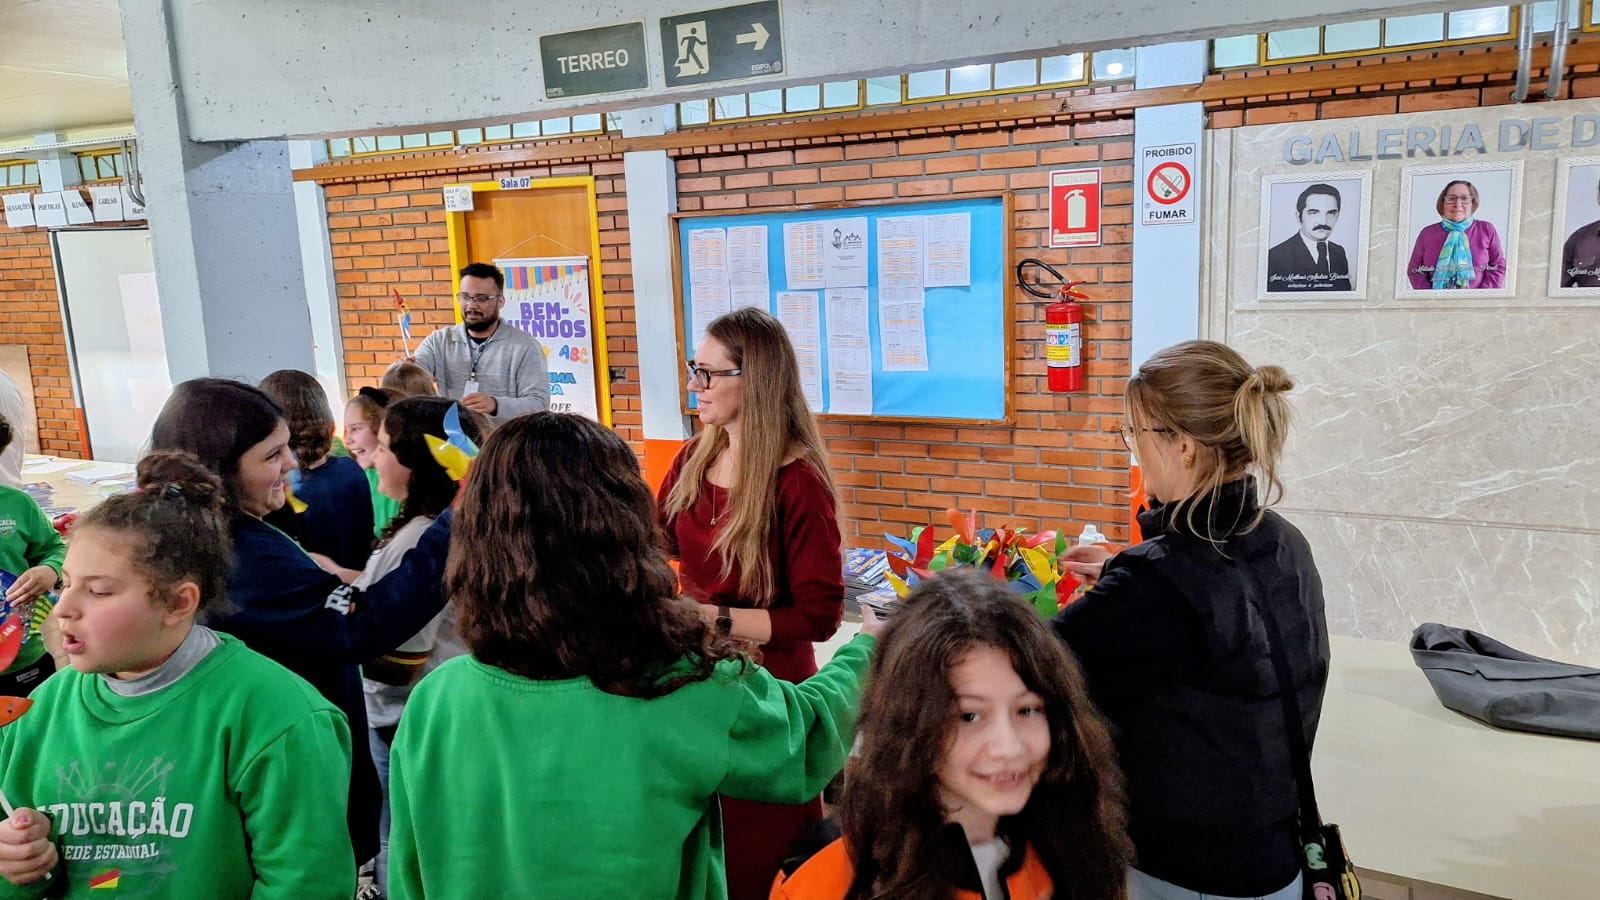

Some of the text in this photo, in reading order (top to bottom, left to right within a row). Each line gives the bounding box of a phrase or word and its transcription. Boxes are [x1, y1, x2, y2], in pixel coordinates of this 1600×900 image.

[557, 48, 629, 75] TERREO
[1283, 114, 1600, 166] GALERIA DE D
[1145, 146, 1193, 158] PROIBIDO
[501, 177, 530, 189] Sala 07
[1149, 209, 1186, 219] FUMAR
[520, 302, 569, 320] BEM-
[559, 344, 589, 364] ABC
[551, 402, 572, 412] OFE
[37, 797, 194, 839] DUCAÇÃO
[62, 842, 160, 860] EDE ESTADUAL
